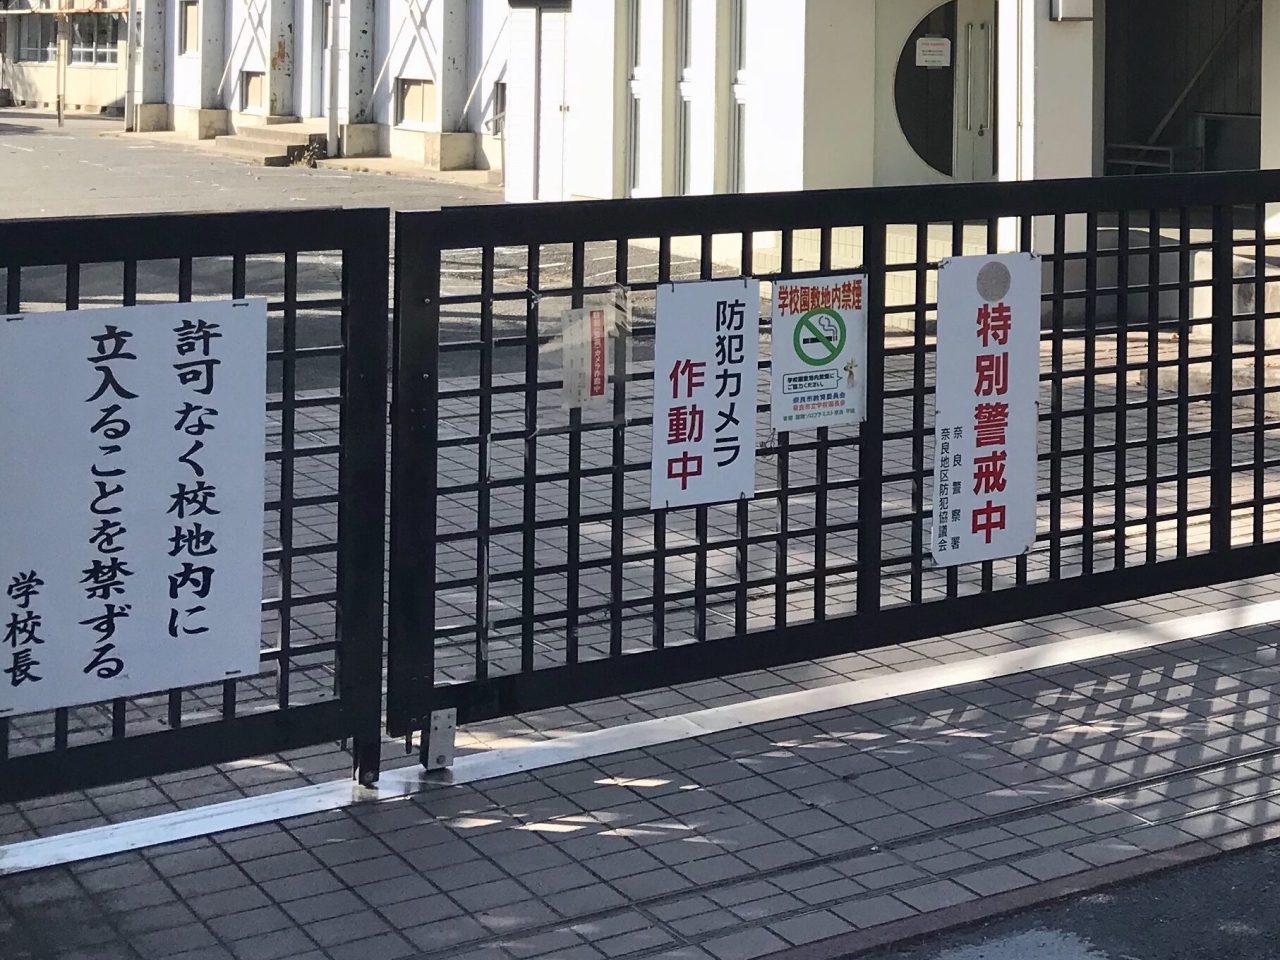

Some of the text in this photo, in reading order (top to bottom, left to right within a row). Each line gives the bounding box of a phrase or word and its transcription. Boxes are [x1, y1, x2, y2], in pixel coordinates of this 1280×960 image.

[778, 279, 863, 317] 学校園敷地内禁煙
[667, 358, 706, 491] 作動中
[713, 299, 746, 468] 防犯カメラ
[971, 302, 1012, 544] 特別警戒中
[78, 323, 140, 681] 立入ることを禁ずる
[166, 318, 223, 639] 許可なく校地内に
[938, 427, 950, 552] 奈良地区防犯協議会
[951, 426, 963, 549] 奈良警察署
[3, 570, 45, 687] 学校長
